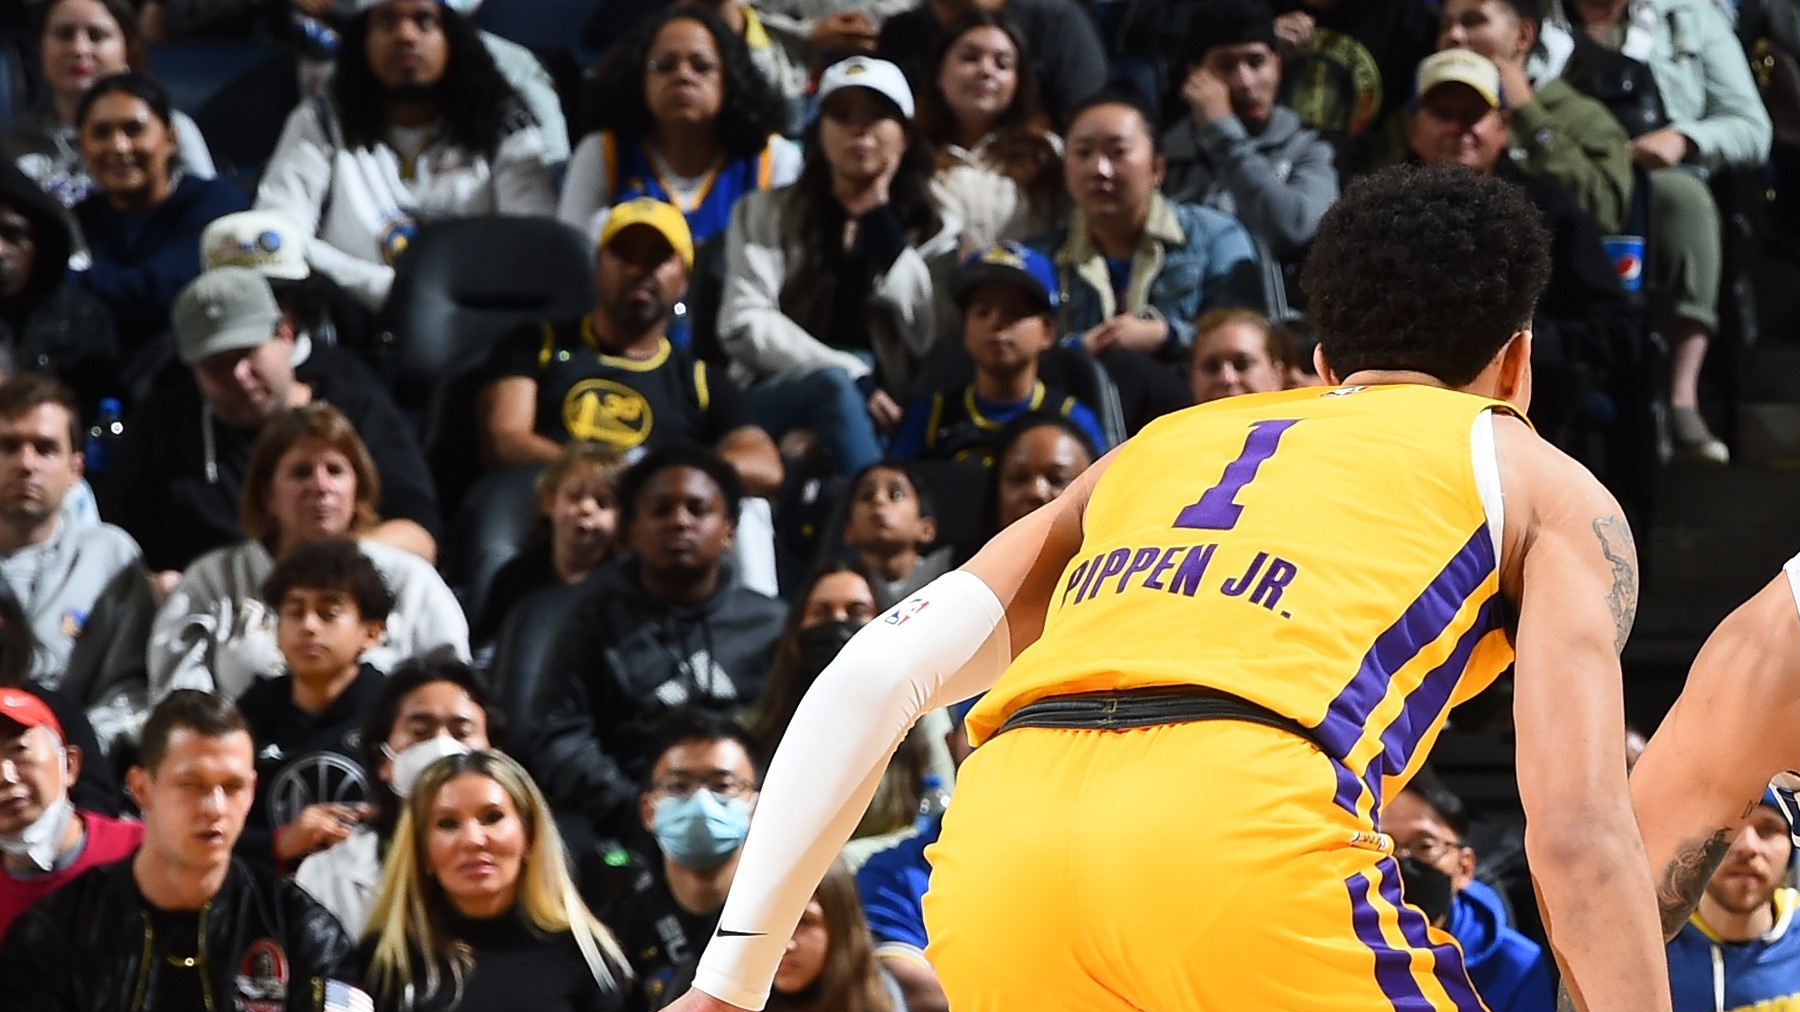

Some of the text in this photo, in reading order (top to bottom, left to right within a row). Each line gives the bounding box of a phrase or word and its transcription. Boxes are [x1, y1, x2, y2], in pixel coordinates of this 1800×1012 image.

[1171, 418, 1304, 530] 1
[1061, 543, 1298, 619] PIPPEN JR.
